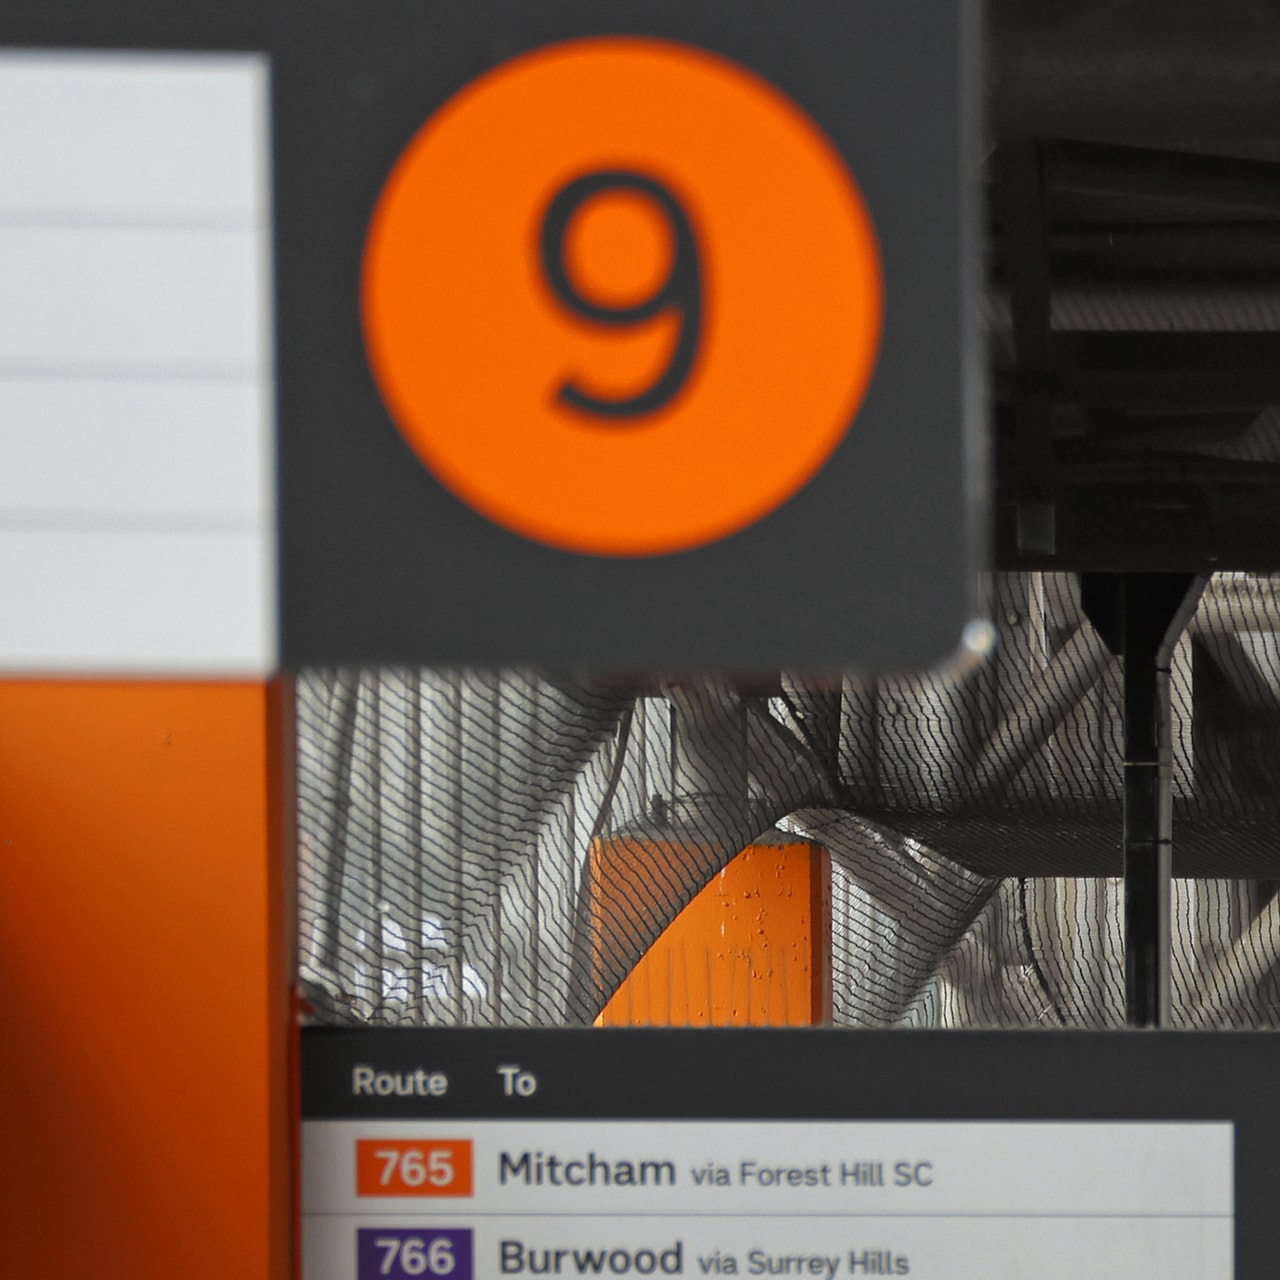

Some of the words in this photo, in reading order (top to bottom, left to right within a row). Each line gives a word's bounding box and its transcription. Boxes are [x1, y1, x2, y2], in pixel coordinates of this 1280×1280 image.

[529, 158, 713, 430] 9
[353, 1067, 448, 1096] Route
[498, 1066, 537, 1097] To
[376, 1149, 455, 1187] 765
[499, 1151, 676, 1186] Mitcham
[690, 1163, 732, 1187] via
[739, 1161, 831, 1187] Forest
[840, 1162, 883, 1187] Hill
[893, 1161, 933, 1188] SC
[376, 1238, 455, 1275] 766
[499, 1240, 683, 1275] Burwood
[697, 1251, 739, 1275] via
[848, 1250, 910, 1276] Hills
